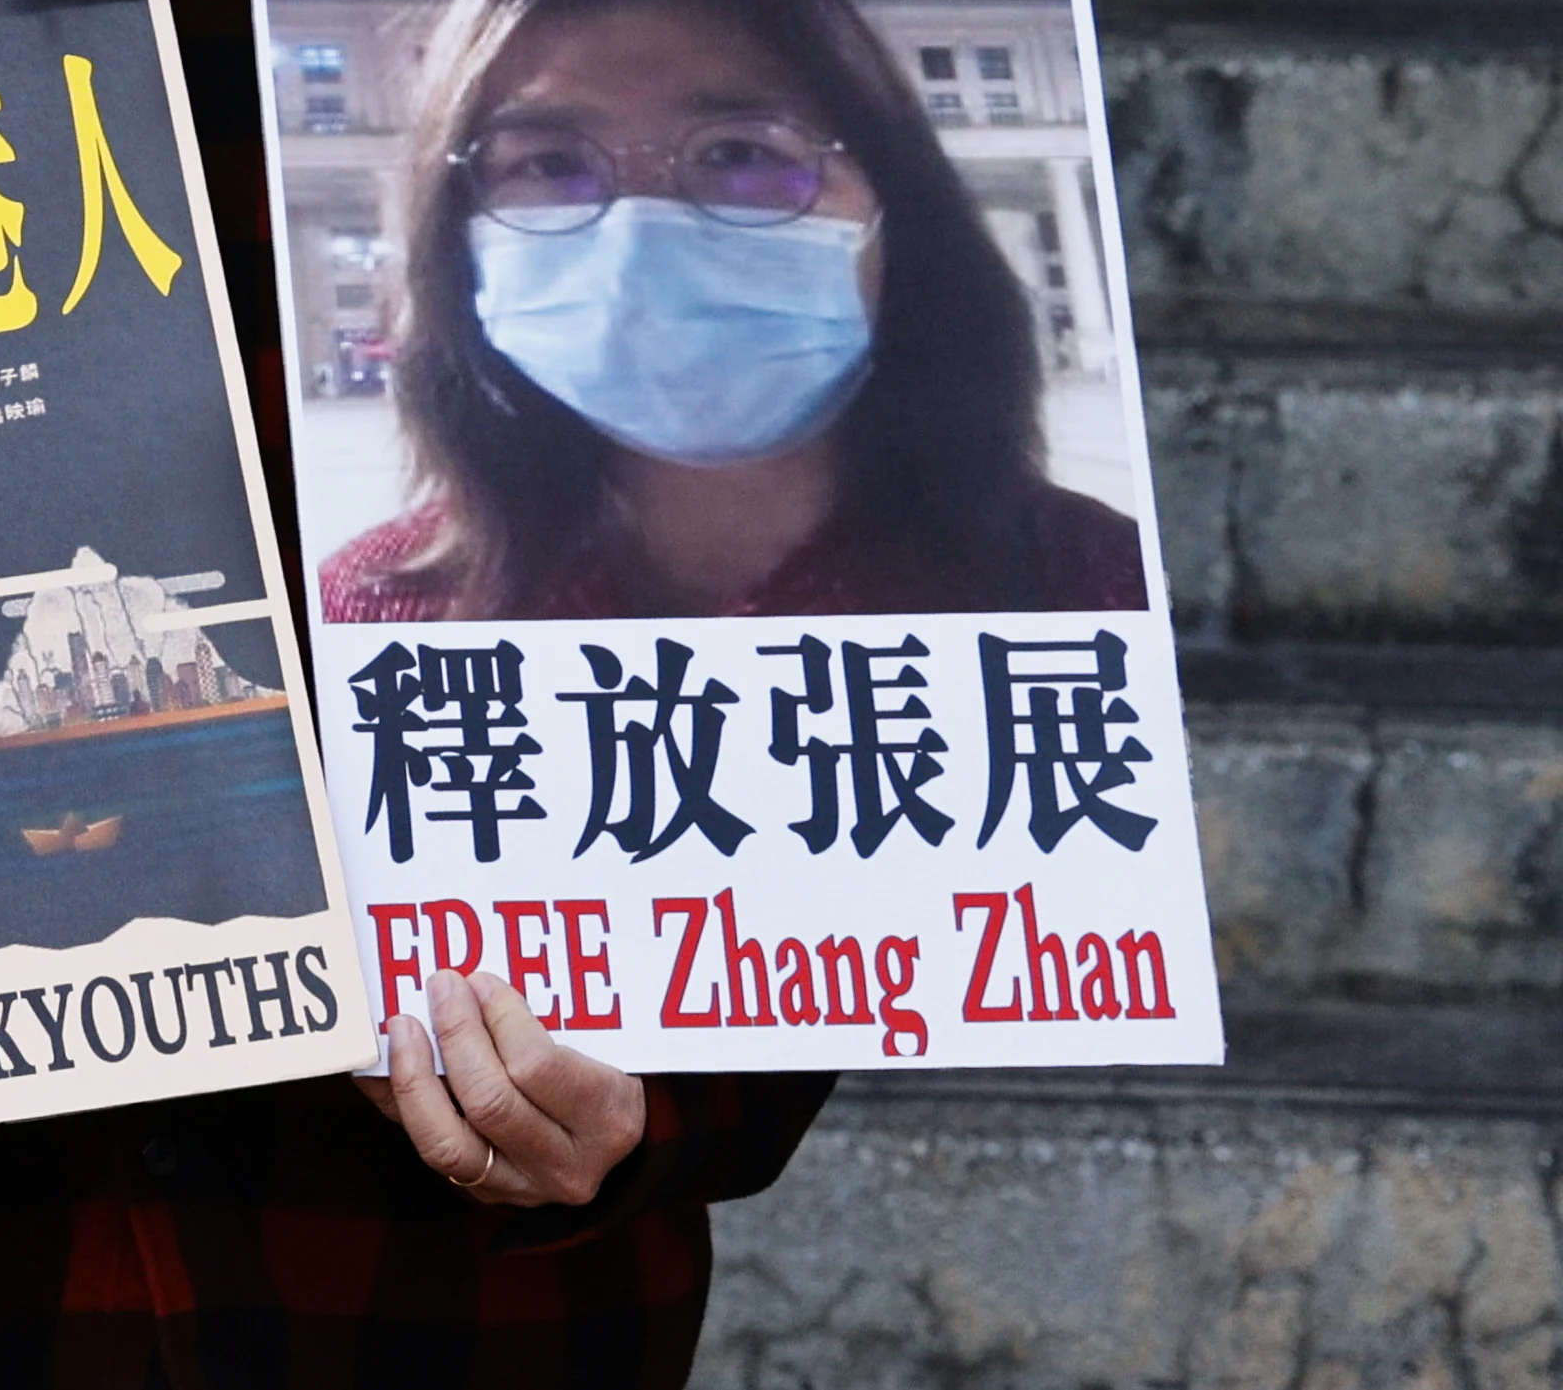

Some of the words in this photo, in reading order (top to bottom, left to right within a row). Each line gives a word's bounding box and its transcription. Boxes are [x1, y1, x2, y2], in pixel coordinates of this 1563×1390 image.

[346, 628, 1160, 864] 釋放張展
[652, 886, 931, 1058] Zhang
[952, 881, 1178, 1024] Zhan
